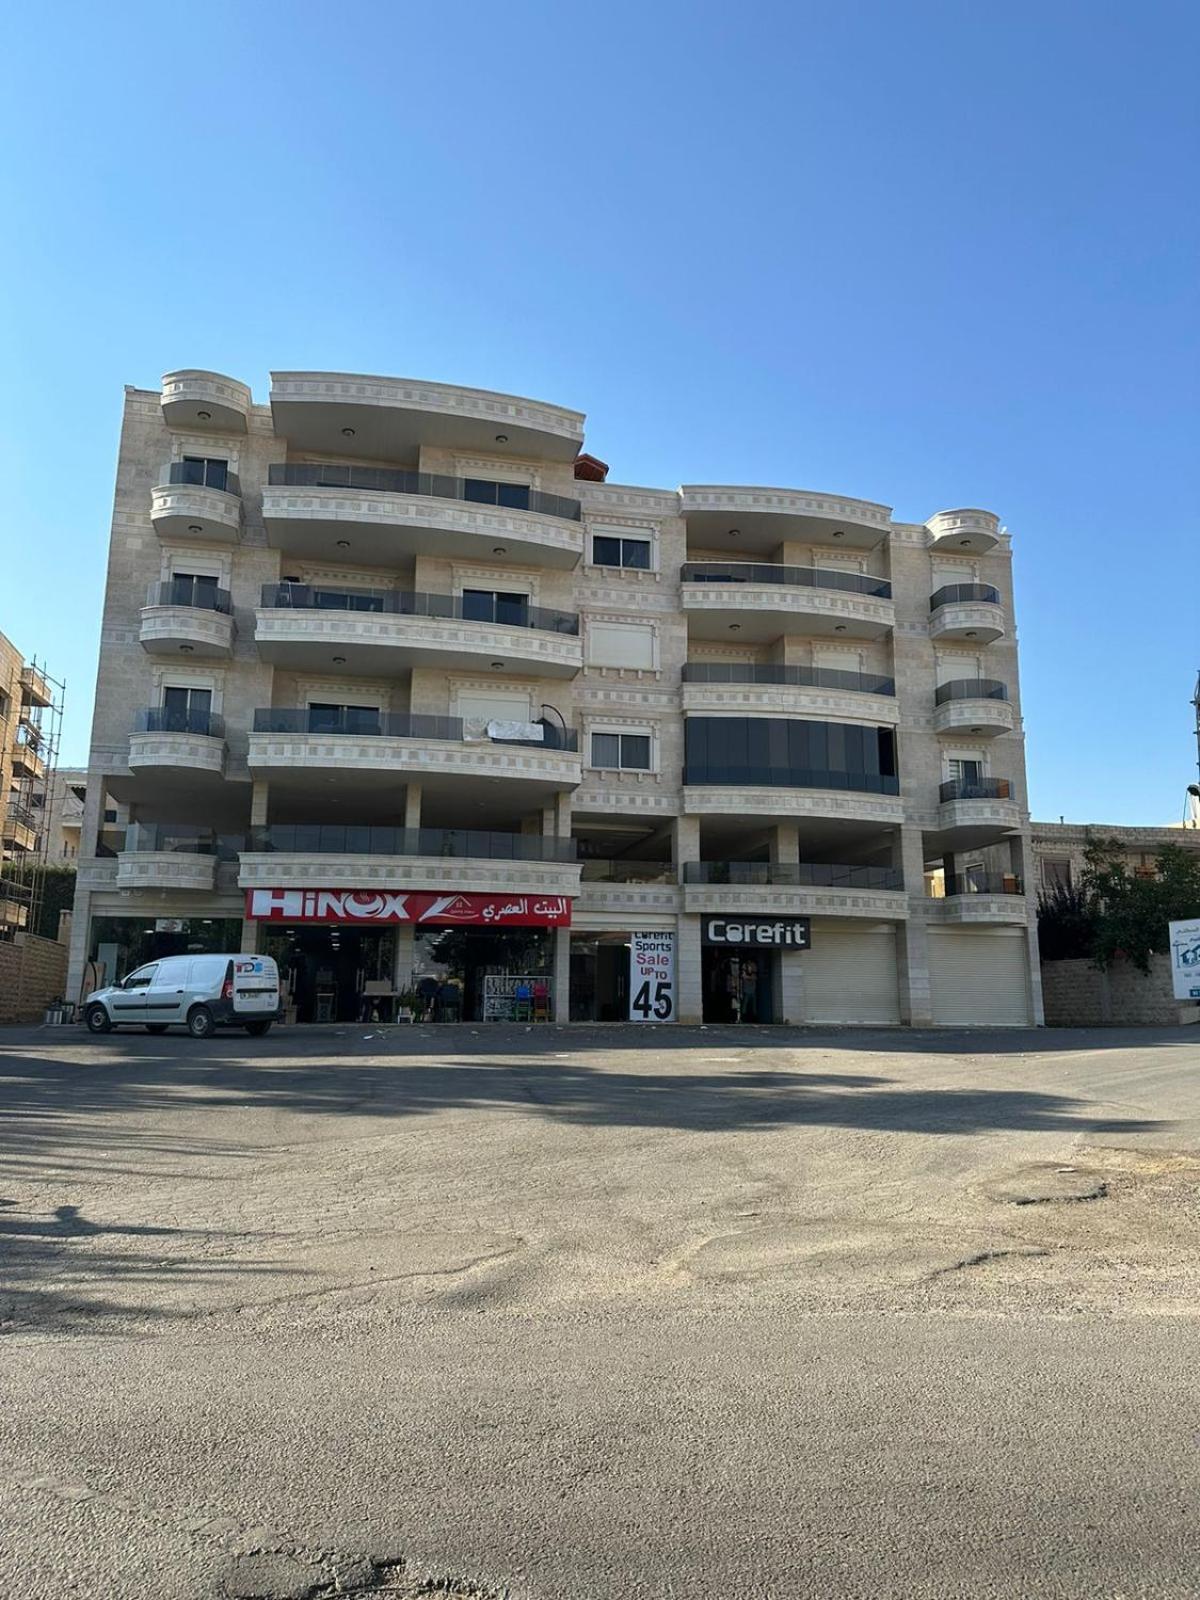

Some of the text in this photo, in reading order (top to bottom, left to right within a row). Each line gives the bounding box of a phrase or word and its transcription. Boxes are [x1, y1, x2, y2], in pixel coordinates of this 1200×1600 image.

[482, 898, 568, 922] البيت العصري
[708, 920, 806, 944] Corefit
[635, 941, 672, 952] Sports
[636, 953, 669, 966] Sale
[641, 967, 668, 980] UP TO
